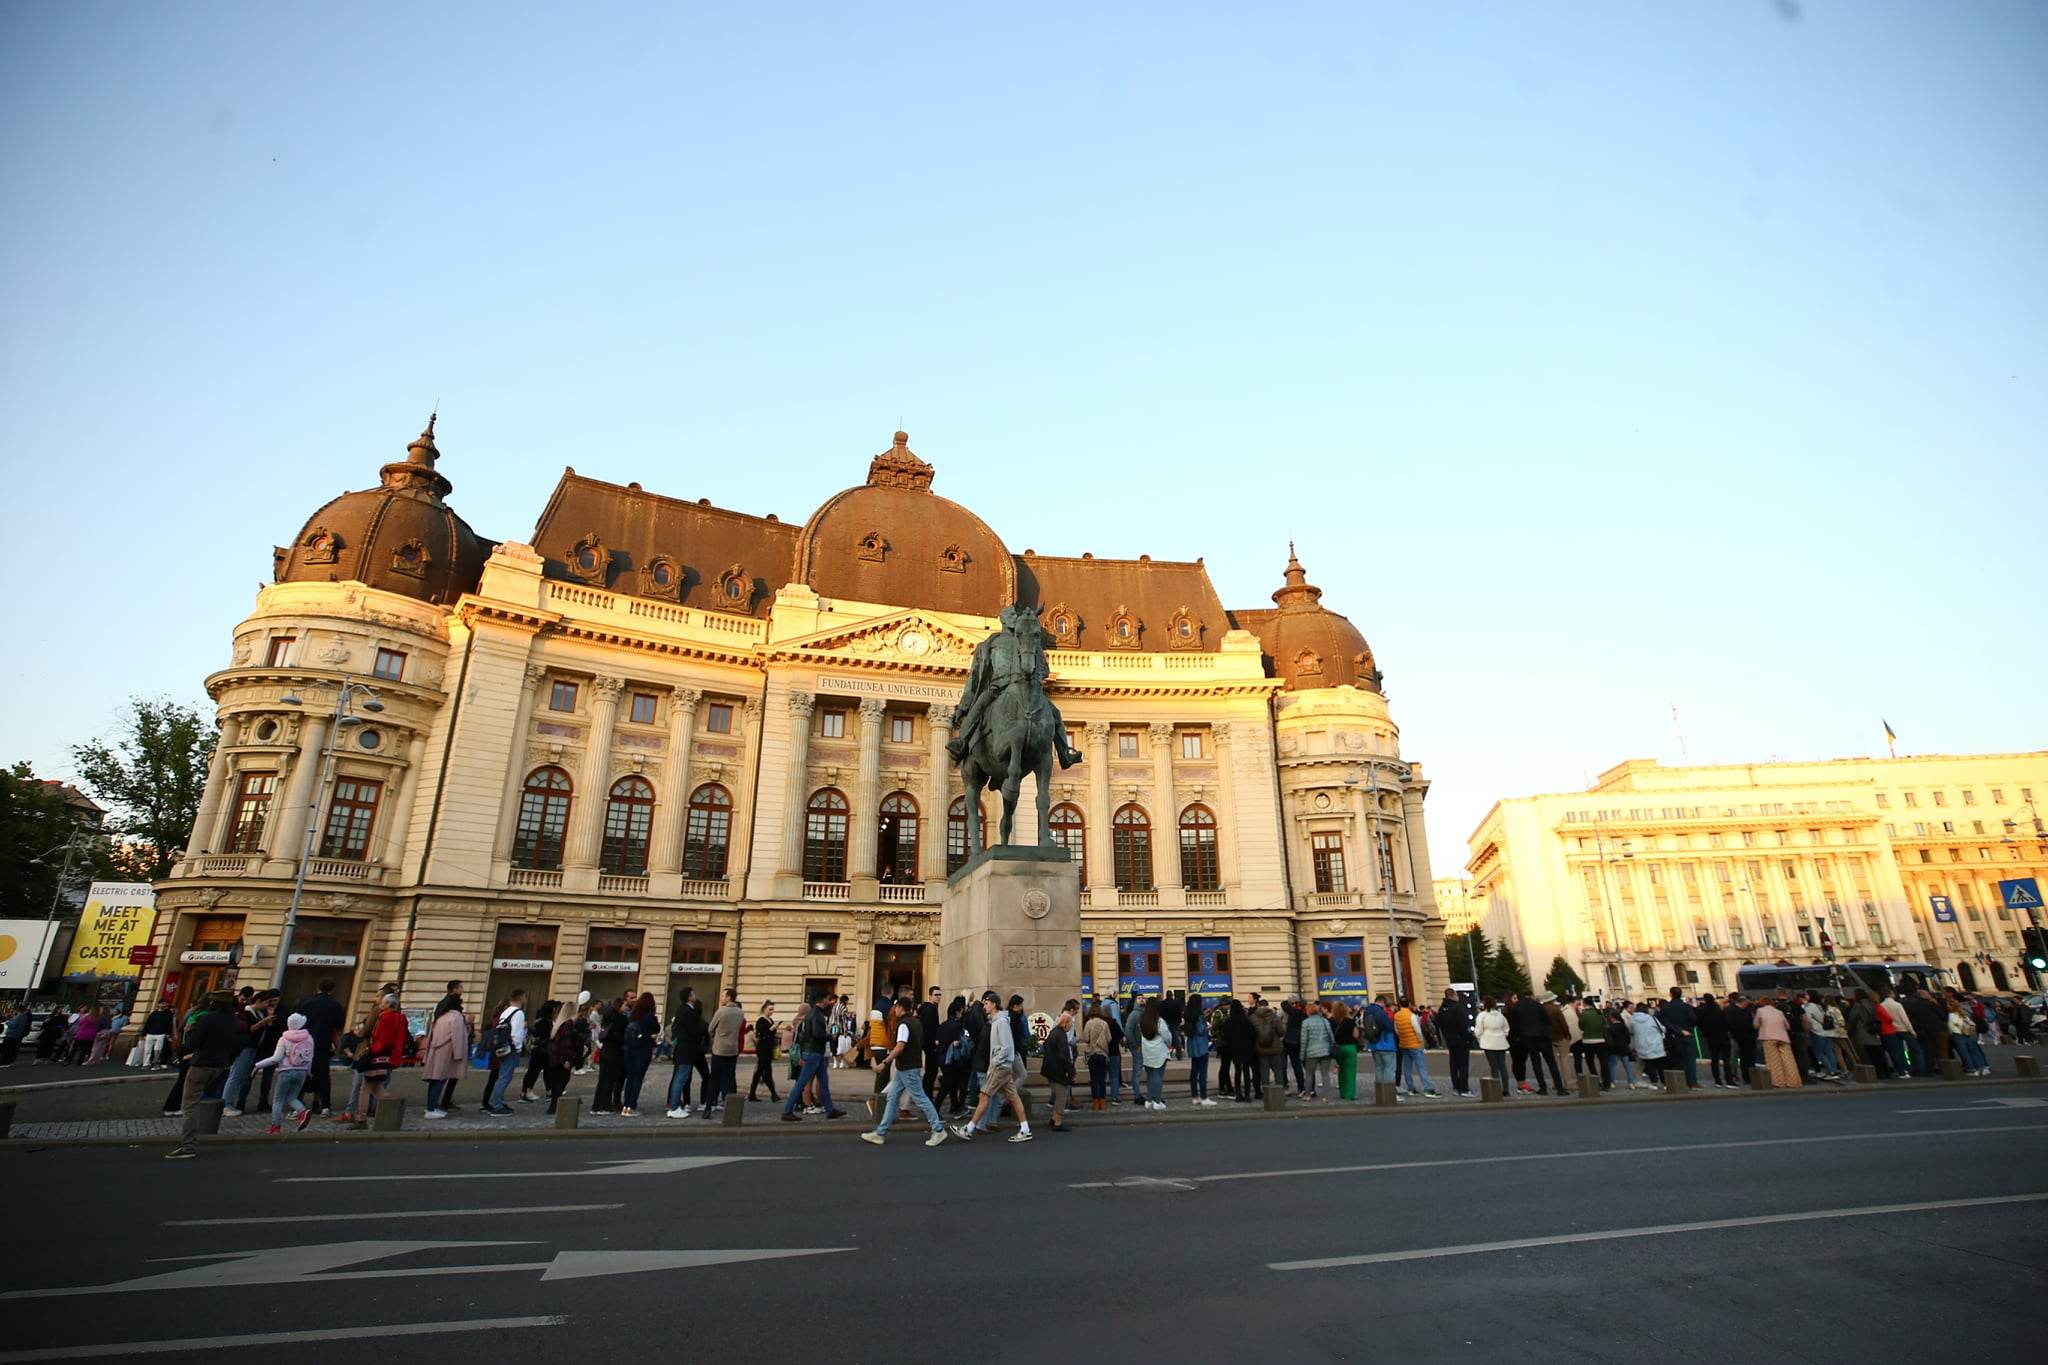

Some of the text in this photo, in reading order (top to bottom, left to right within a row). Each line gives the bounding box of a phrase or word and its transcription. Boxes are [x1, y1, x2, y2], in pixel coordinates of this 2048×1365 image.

[887, 684, 953, 698] UNIVERSITARA
[91, 887, 154, 896] ELECTRIC CASTL
[99, 905, 141, 918] MEET
[93, 919, 139, 931] ME AT
[98, 932, 127, 945] THE
